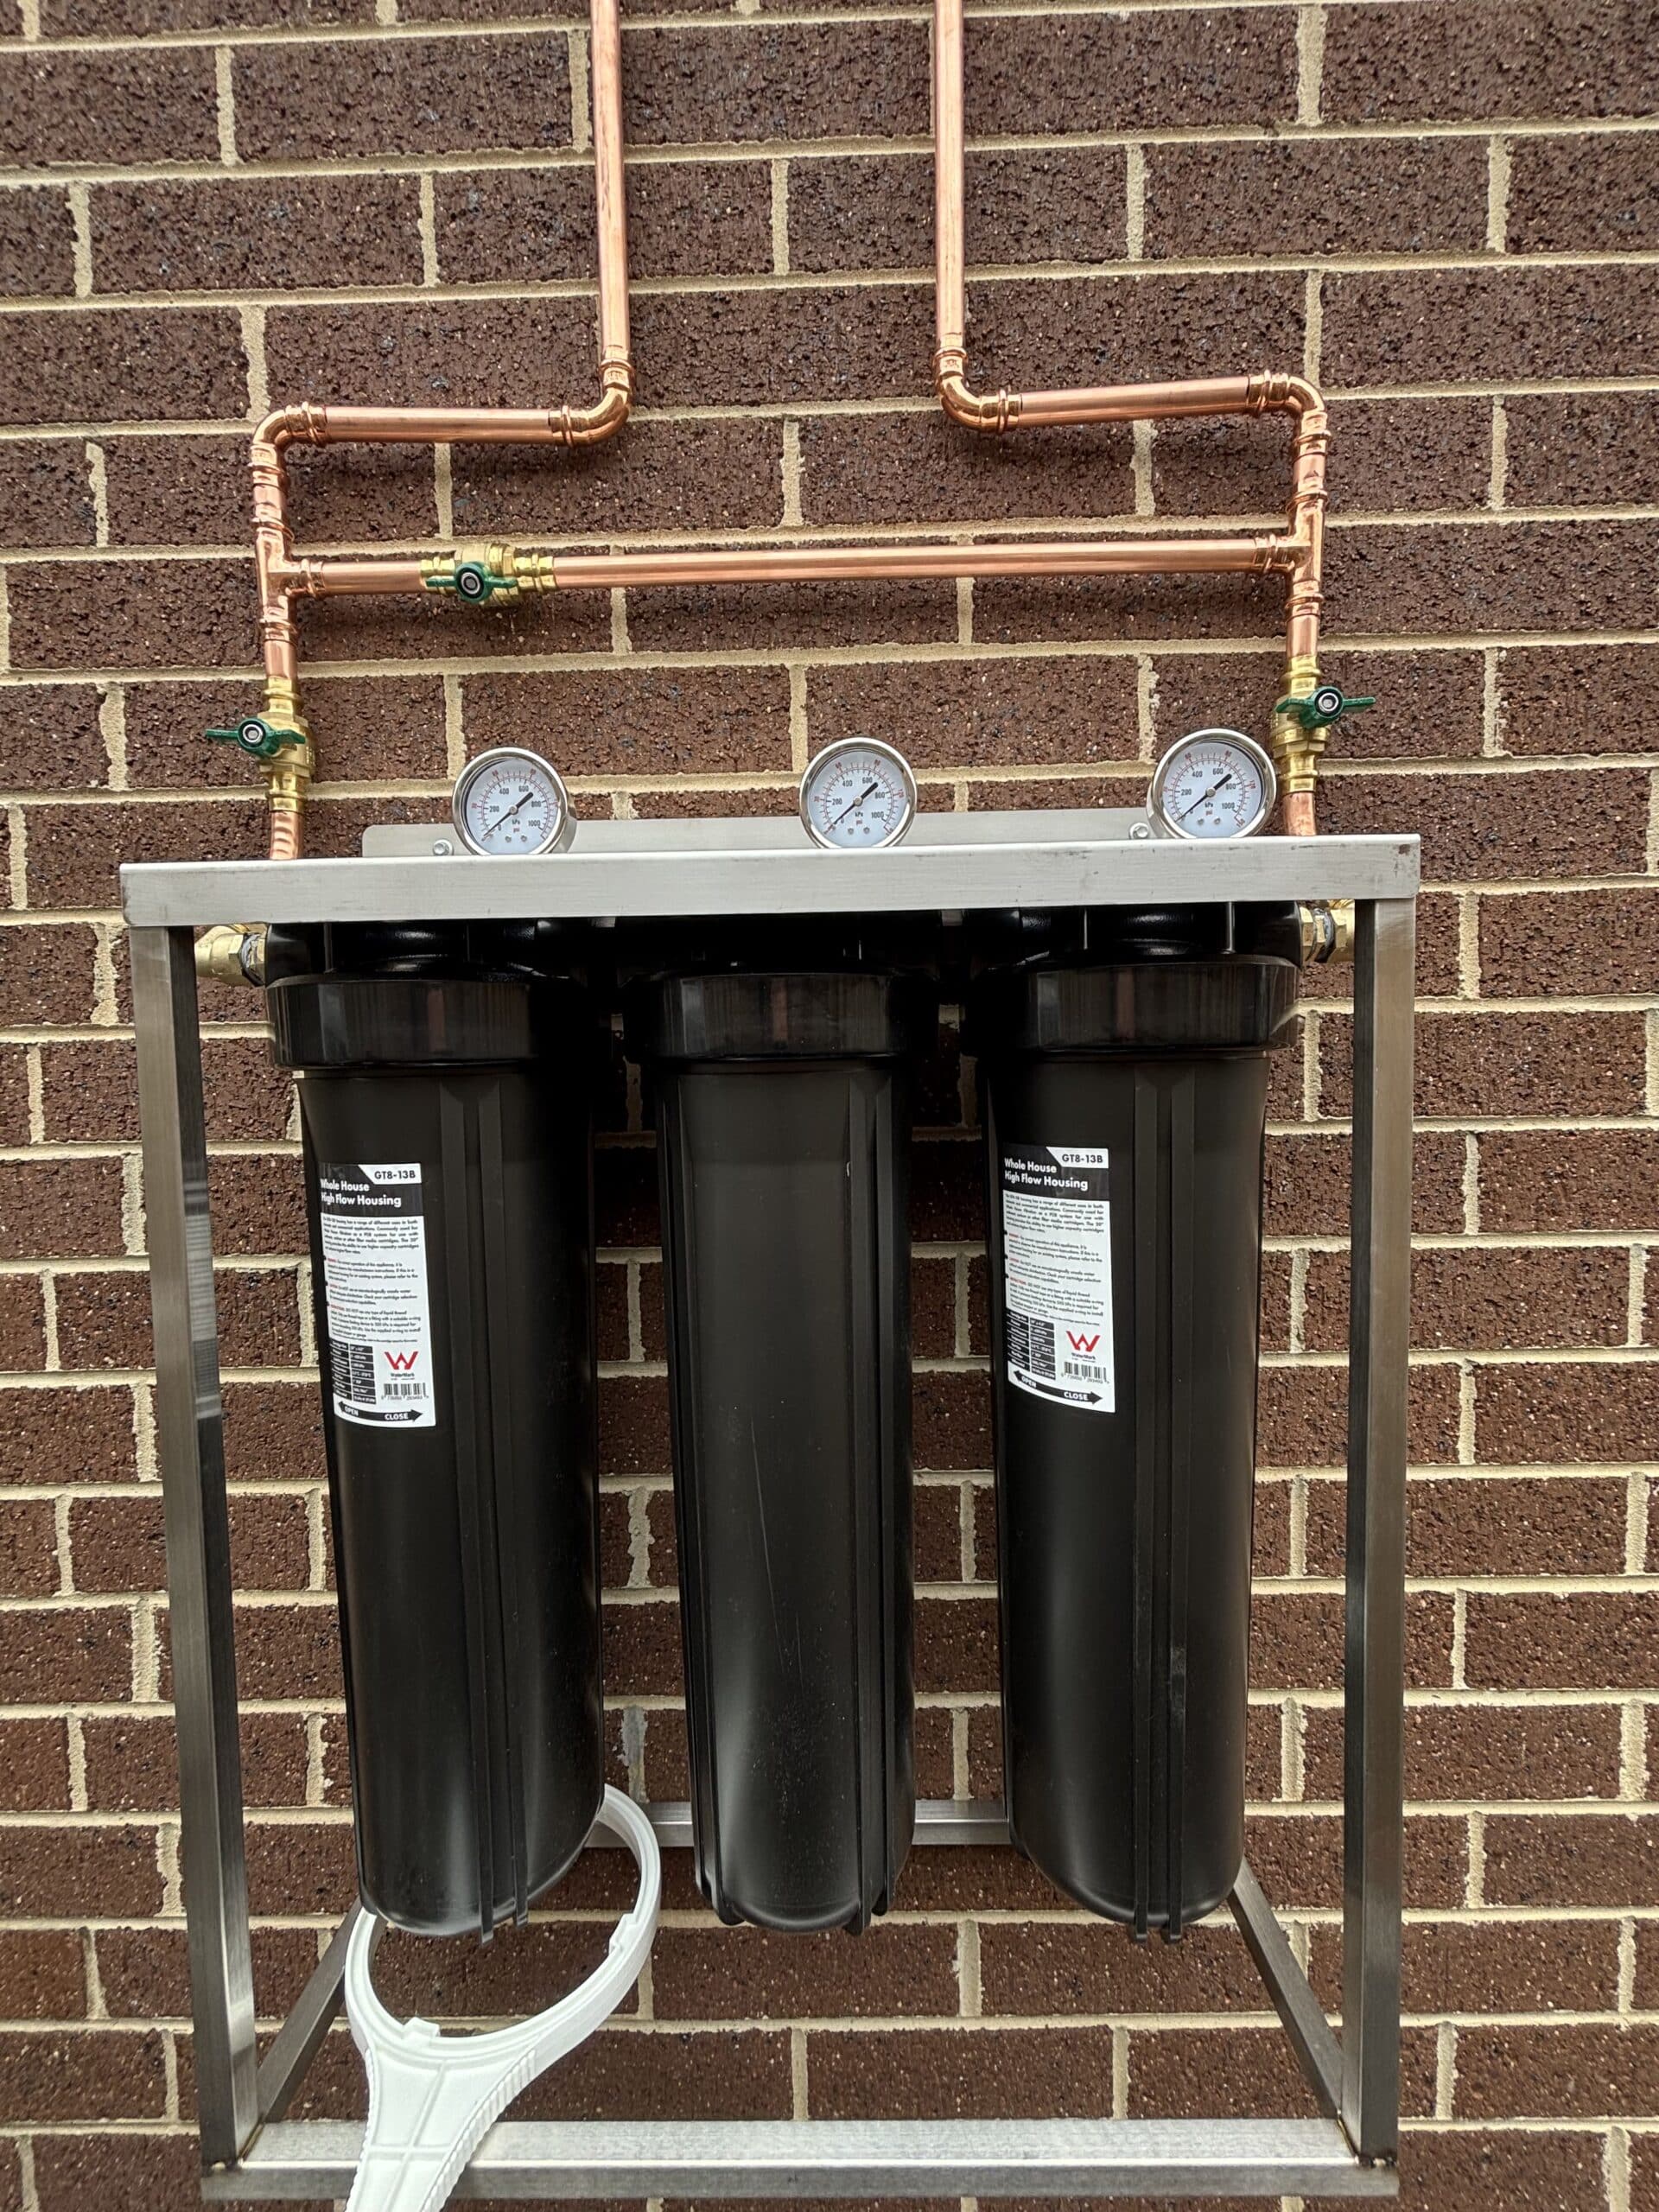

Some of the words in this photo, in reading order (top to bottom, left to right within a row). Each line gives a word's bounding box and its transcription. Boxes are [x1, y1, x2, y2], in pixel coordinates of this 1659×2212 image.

[1062, 1154, 1103, 1163] GT8-13B
[1004, 1158, 1025, 1170] Whole
[1027, 1161, 1057, 1173] House
[375, 1170, 415, 1179] GT8-13B
[321, 1179, 340, 1190] Whole
[341, 1180, 369, 1191] House
[1005, 1170, 1020, 1183] High
[1021, 1173, 1041, 1185] Flow
[1044, 1176, 1088, 1192] Housing
[335, 1193, 355, 1205] Flow
[358, 1195, 401, 1207] Housing
[1021, 1376, 1037, 1388] OPEN
[1064, 1392, 1089, 1401] CLOSE
[345, 1406, 359, 1415] OPEN
